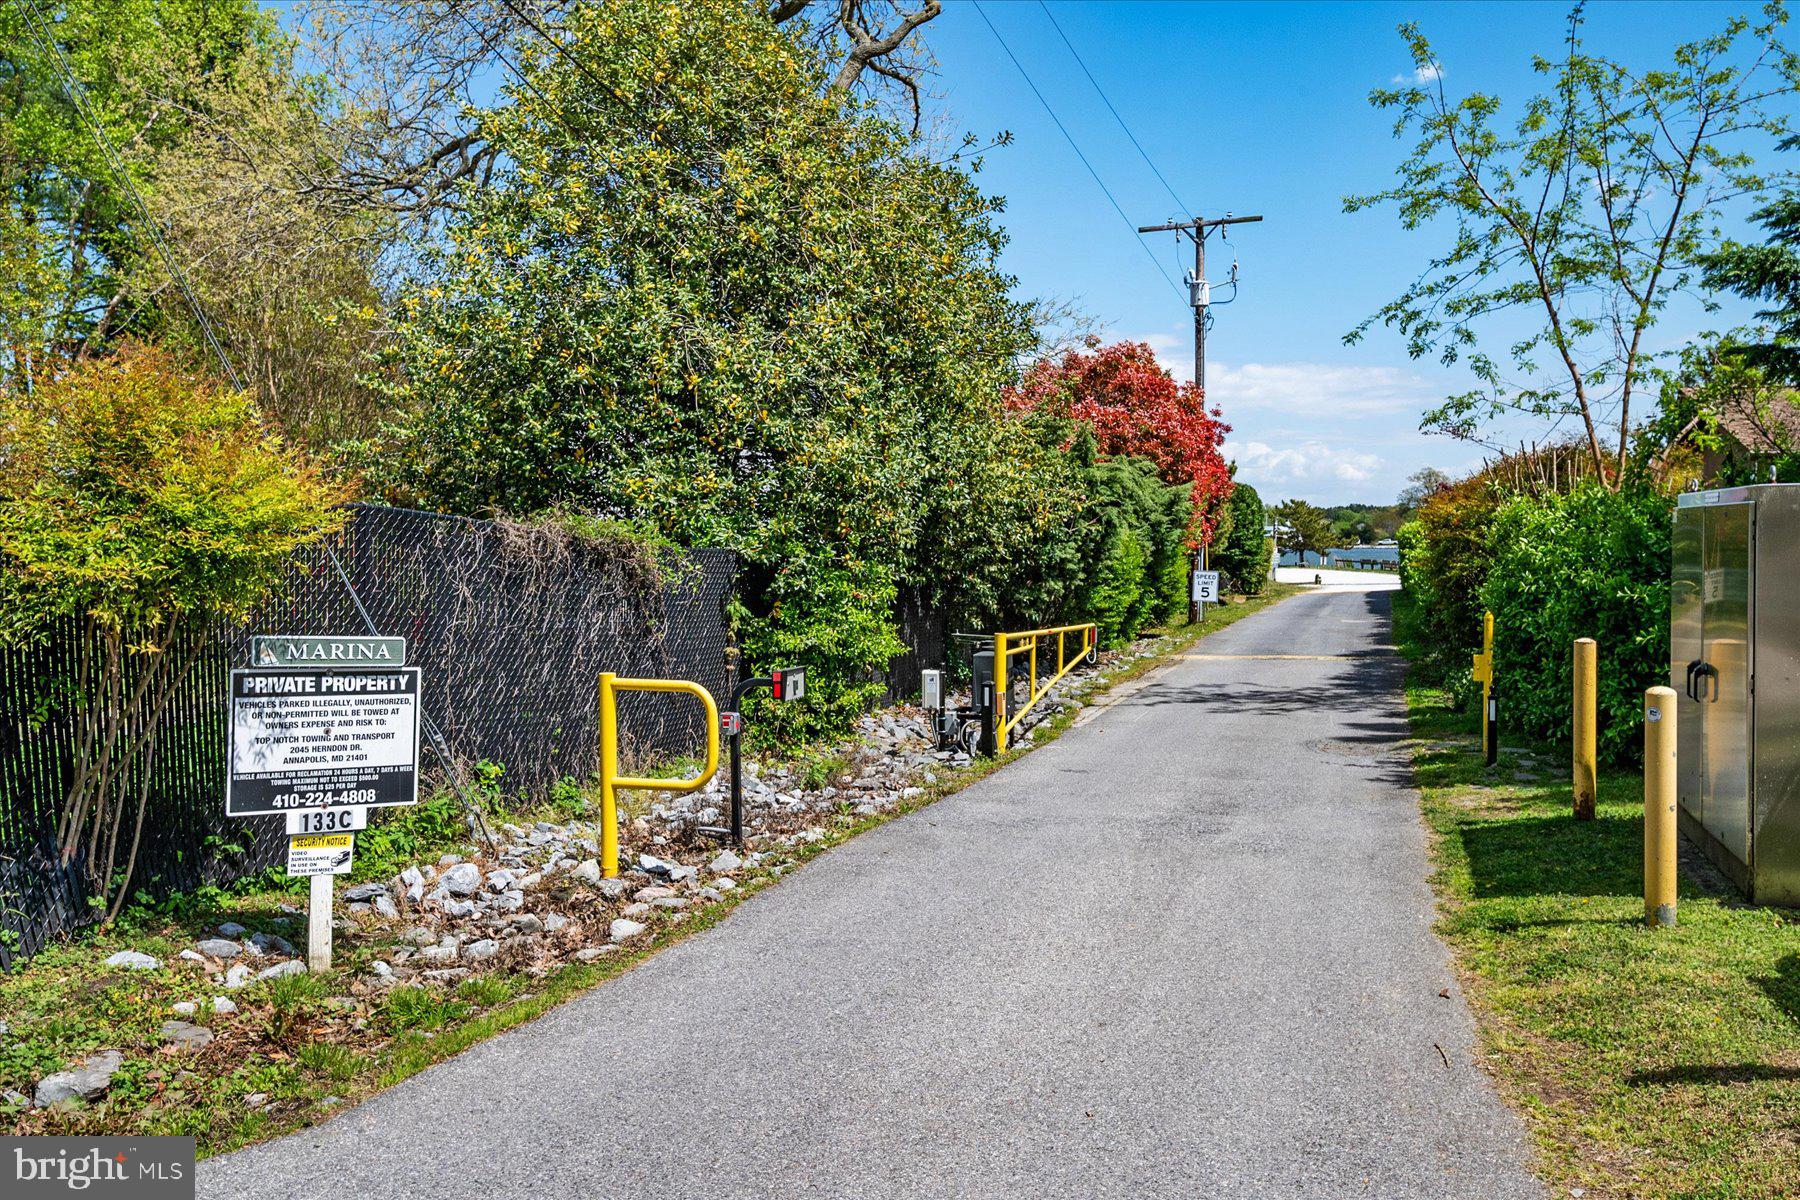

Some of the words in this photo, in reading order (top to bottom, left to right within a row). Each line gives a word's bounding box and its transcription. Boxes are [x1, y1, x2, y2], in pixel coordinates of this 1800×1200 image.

[1201, 587, 1209, 598] 5
[286, 643, 391, 660] MARINA
[243, 676, 315, 693] PRIVATE
[321, 675, 409, 692] PROPERTY
[239, 700, 276, 709] VEHICLES
[279, 700, 310, 708] PARKED
[312, 699, 352, 708] ILLEGALLY,
[354, 698, 411, 706] UNAUTHORIZED,
[265, 710, 328, 719] NON-PERMITTED
[265, 721, 298, 730] OWNERS
[301, 720, 335, 728] EXPENSE
[272, 736, 299, 744] NOTCH
[302, 735, 331, 743] TOWING
[352, 732, 395, 740] TRANSPORT
[312, 745, 348, 753] HERNDON
[283, 756, 329, 764] ANNAPOLIS,
[272, 789, 376, 808] 410-224-4808
[302, 810, 352, 832] 133C
[296, 838, 325, 847] SECURITY
[326, 837, 347, 846] NOTICE
